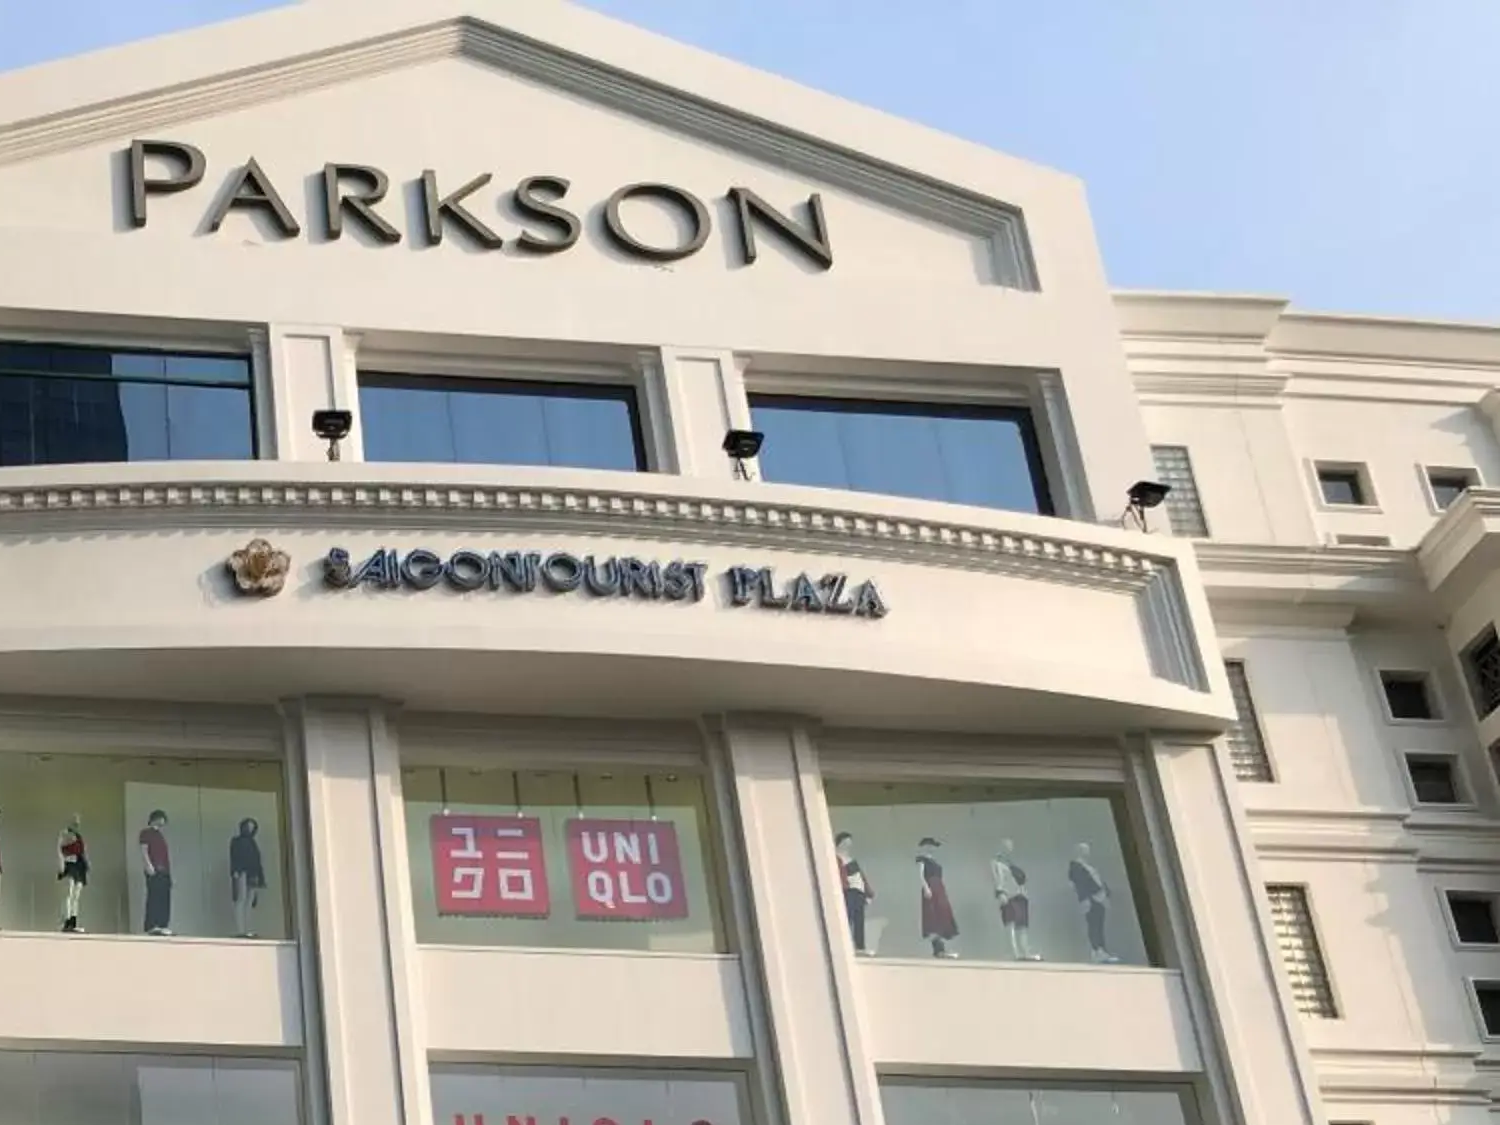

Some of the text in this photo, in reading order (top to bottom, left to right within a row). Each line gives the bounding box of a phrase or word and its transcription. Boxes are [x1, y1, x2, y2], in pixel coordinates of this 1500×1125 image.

[130, 138, 833, 271] PARKSON
[323, 546, 889, 619] SAIGONTOURIST PLAZA
[581, 831, 660, 865] UNI
[587, 870, 673, 908] QLO
